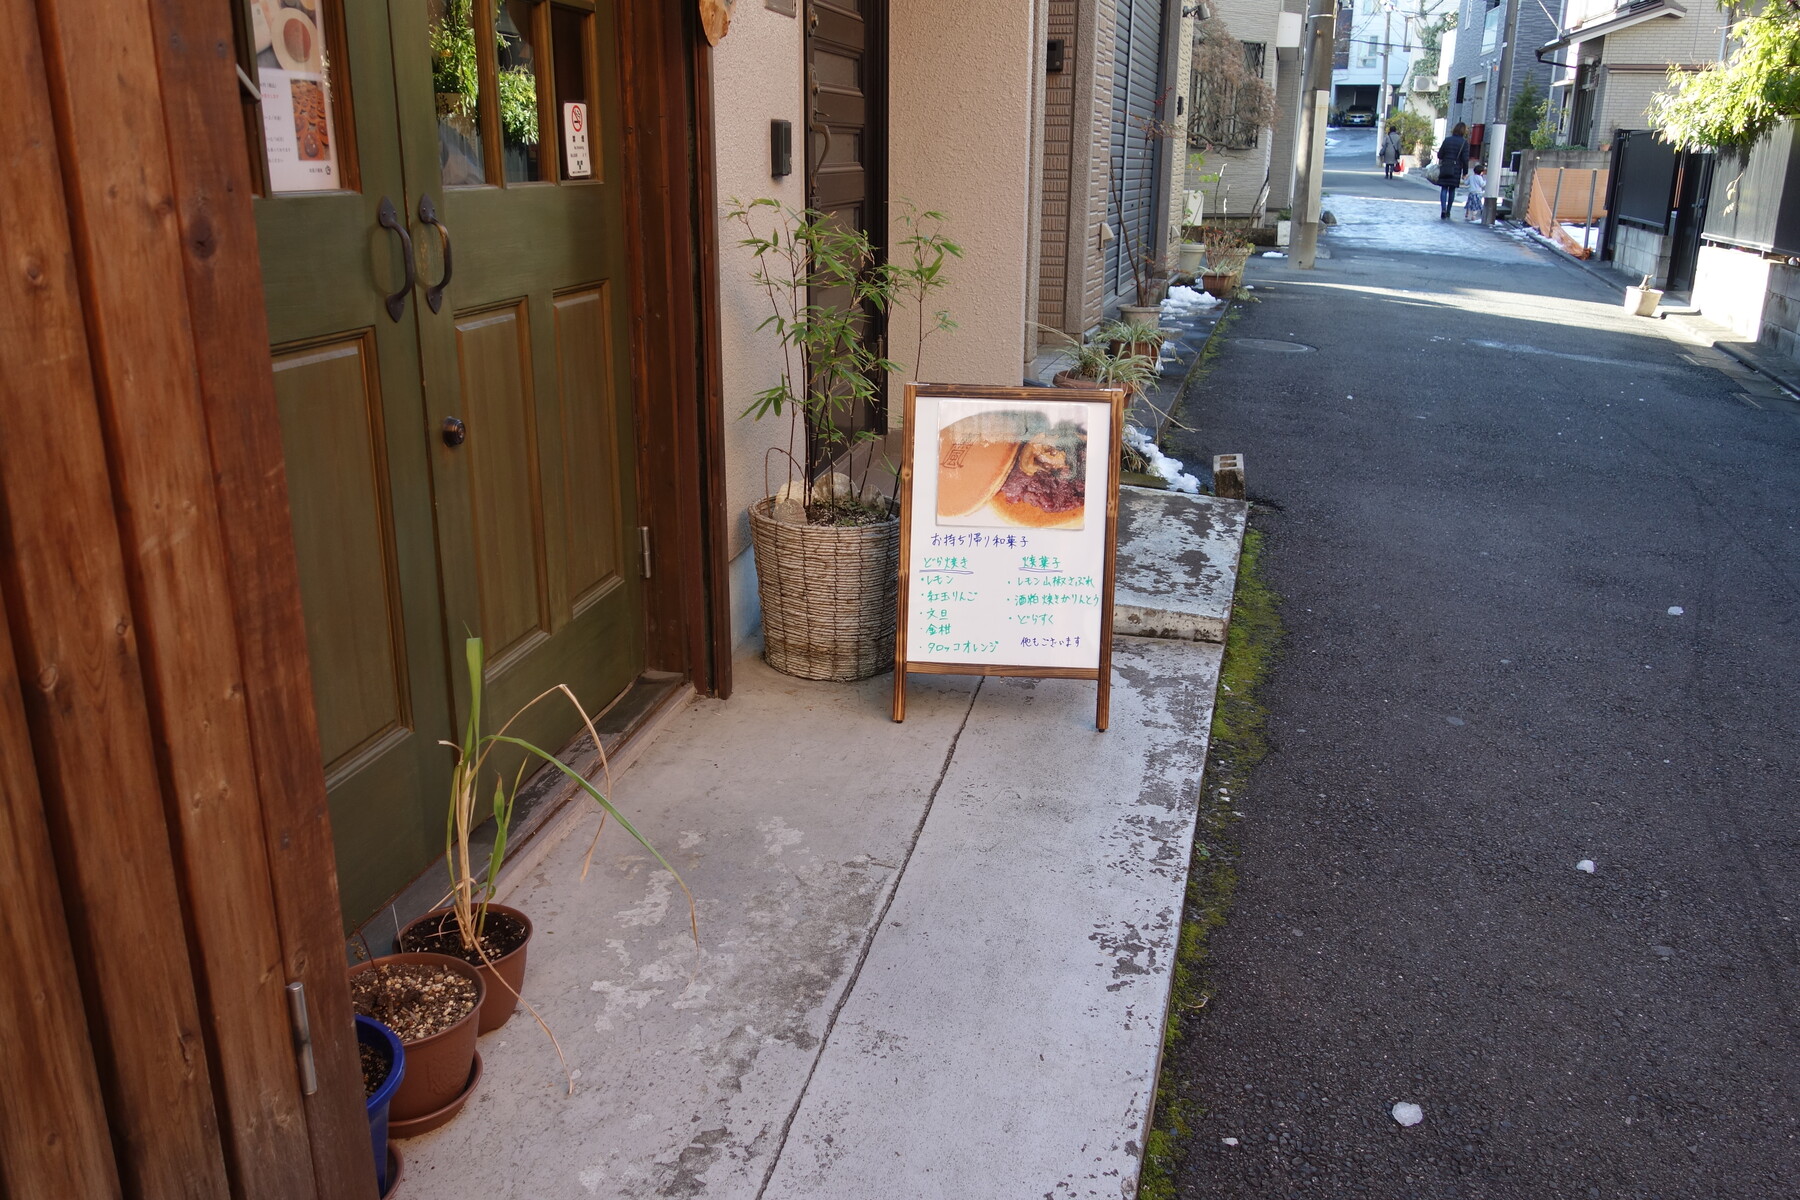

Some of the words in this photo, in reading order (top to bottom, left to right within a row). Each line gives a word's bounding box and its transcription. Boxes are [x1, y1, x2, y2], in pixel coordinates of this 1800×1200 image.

[930, 532, 1029, 549] お持ち帰り和菓子
[923, 556, 968, 570] どら焼き
[1022, 555, 1060, 569] 焼菓子
[926, 575, 954, 585] レモン
[927, 590, 978, 602] 紅玉りんご
[926, 608, 949, 621] 文旦
[1017, 613, 1054, 626] どらすく
[926, 623, 951, 636] 金柑
[927, 640, 999, 654] タロッコオレンジ
